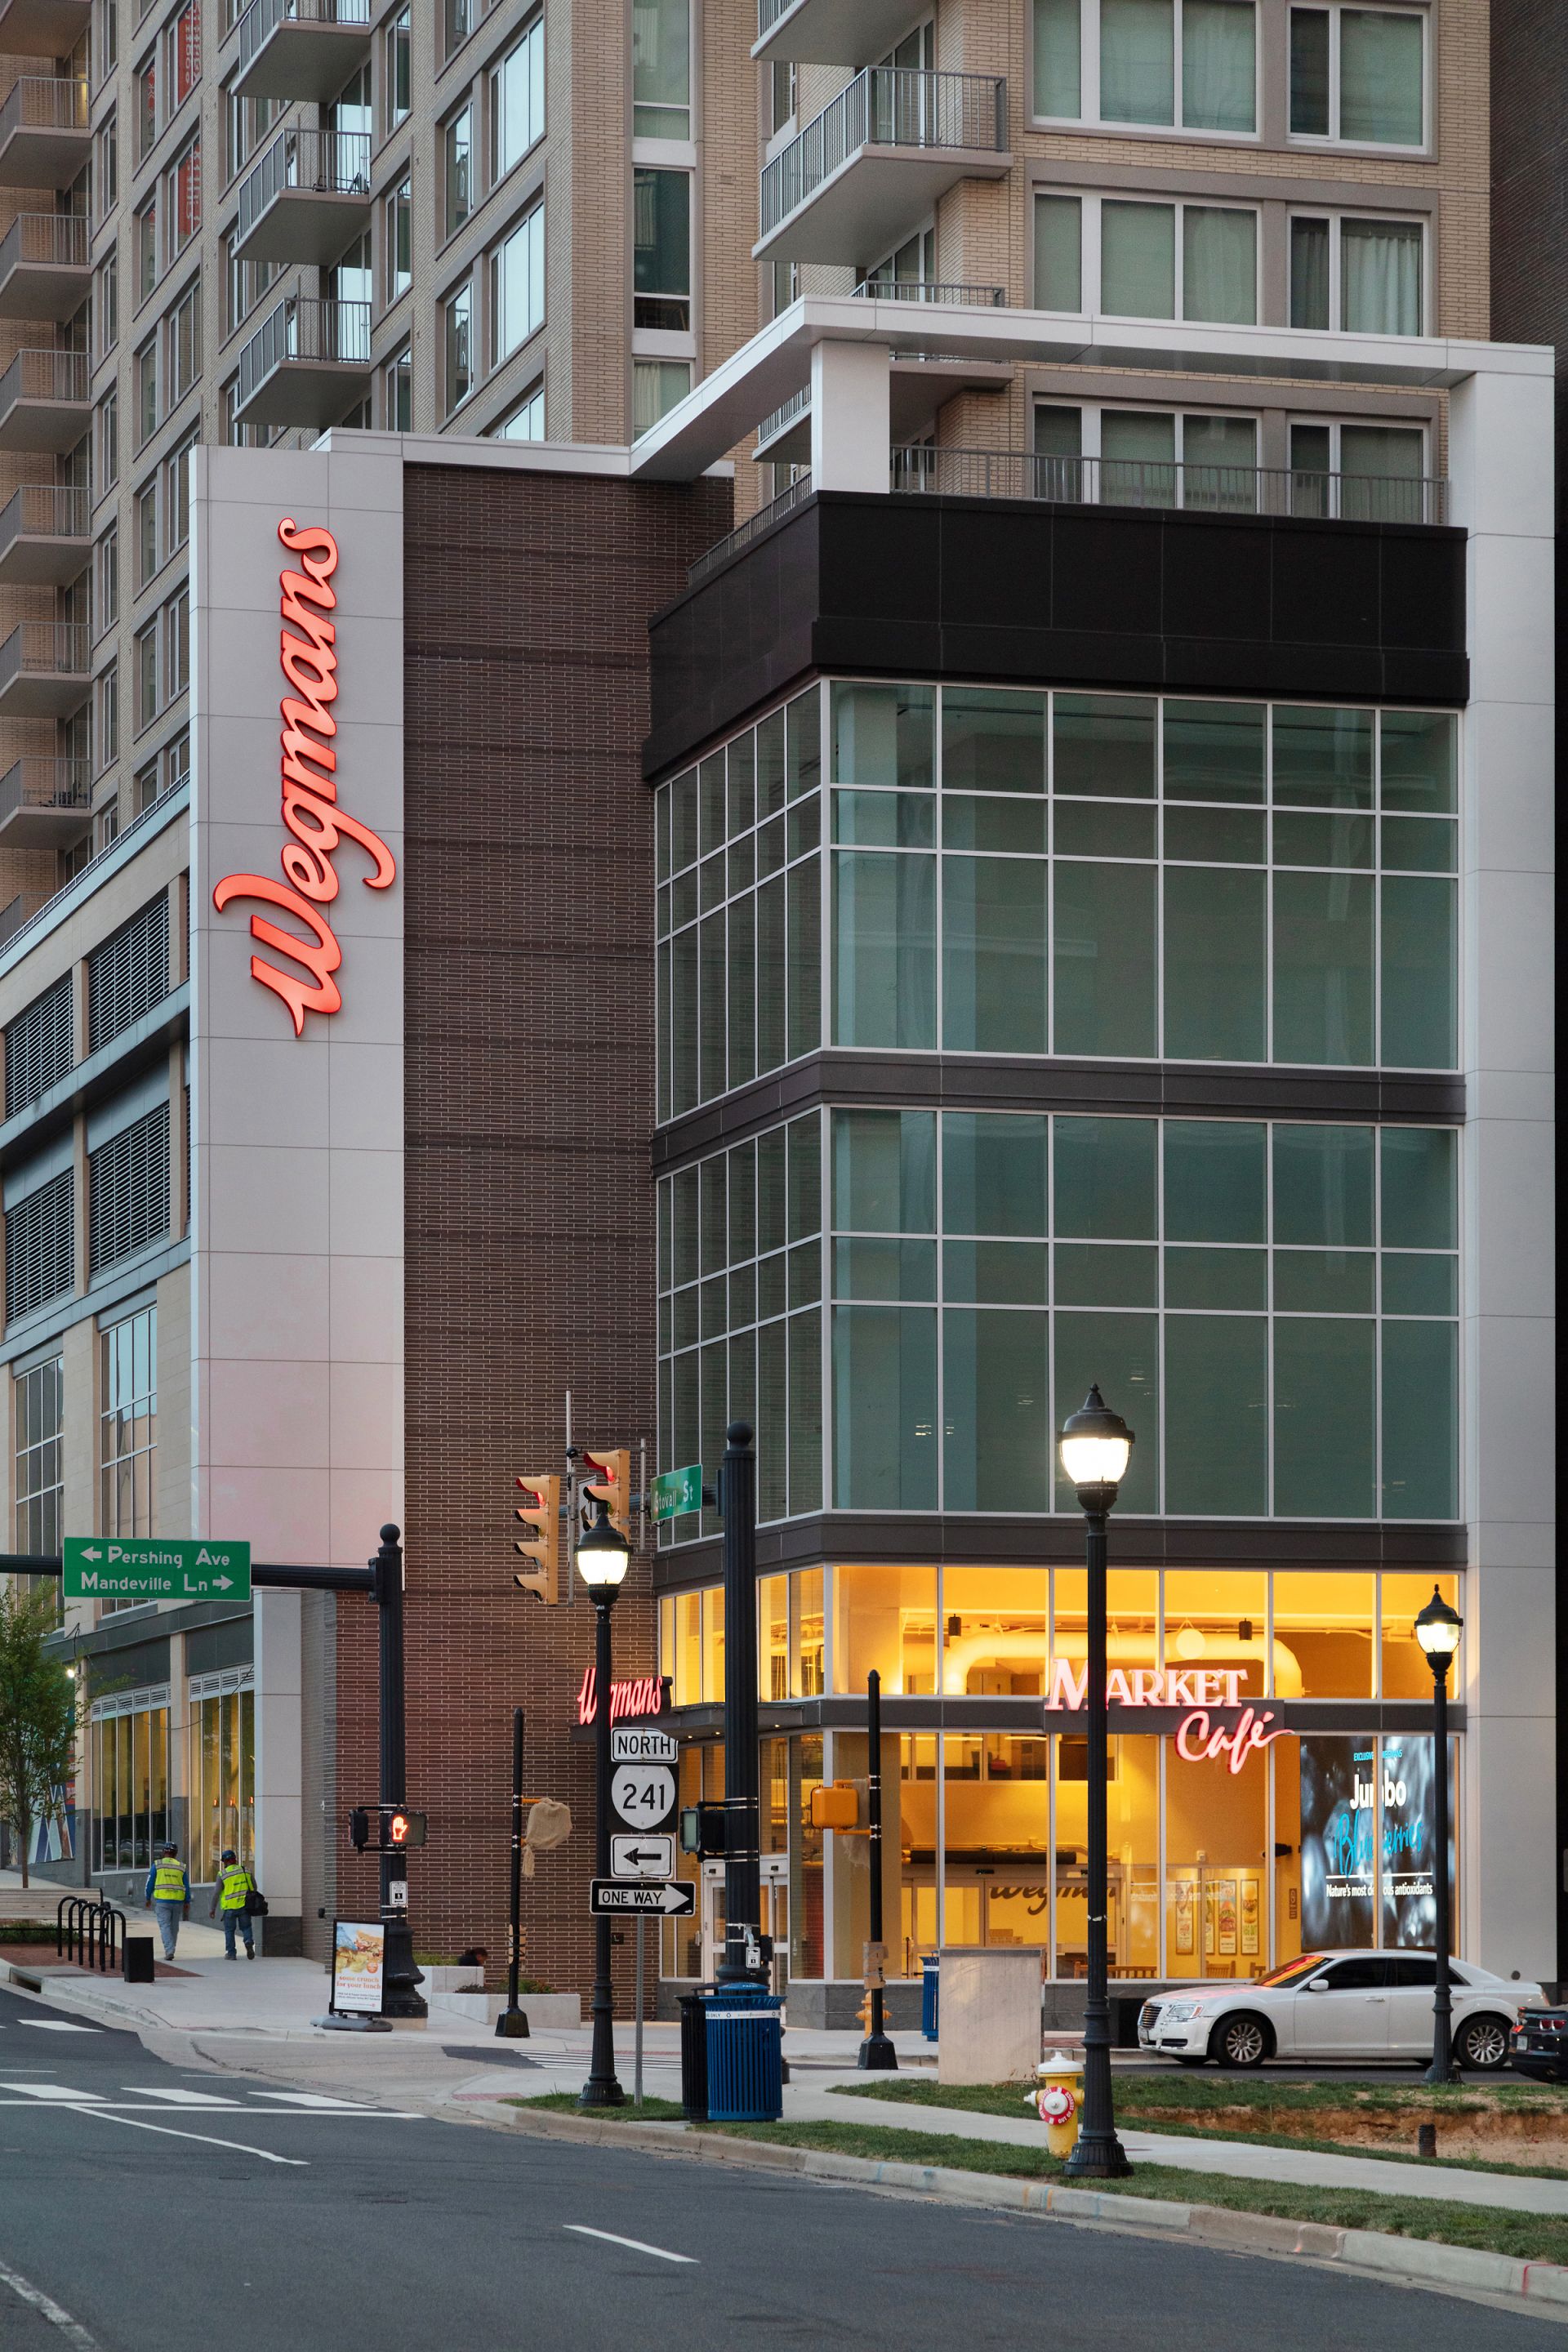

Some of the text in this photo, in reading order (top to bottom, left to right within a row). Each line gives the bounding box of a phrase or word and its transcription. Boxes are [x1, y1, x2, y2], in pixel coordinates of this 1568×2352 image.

[212, 517, 397, 1037] Wegmans
[683, 1479, 693, 1503] St
[108, 1545, 231, 1568] Pershing Ave
[81, 1571, 208, 1592] Mandeville Ln
[617, 1735, 671, 1755] NORTH
[1175, 1707, 1295, 1775] Café
[622, 1783, 665, 1811] 241
[1334, 1809, 1425, 1878] Bluerries
[602, 1891, 662, 1904] ONE WAY
[1326, 1882, 1351, 1898] Nature's
[1352, 1884, 1367, 1897] most
[1395, 1881, 1433, 1896] antioxidants
